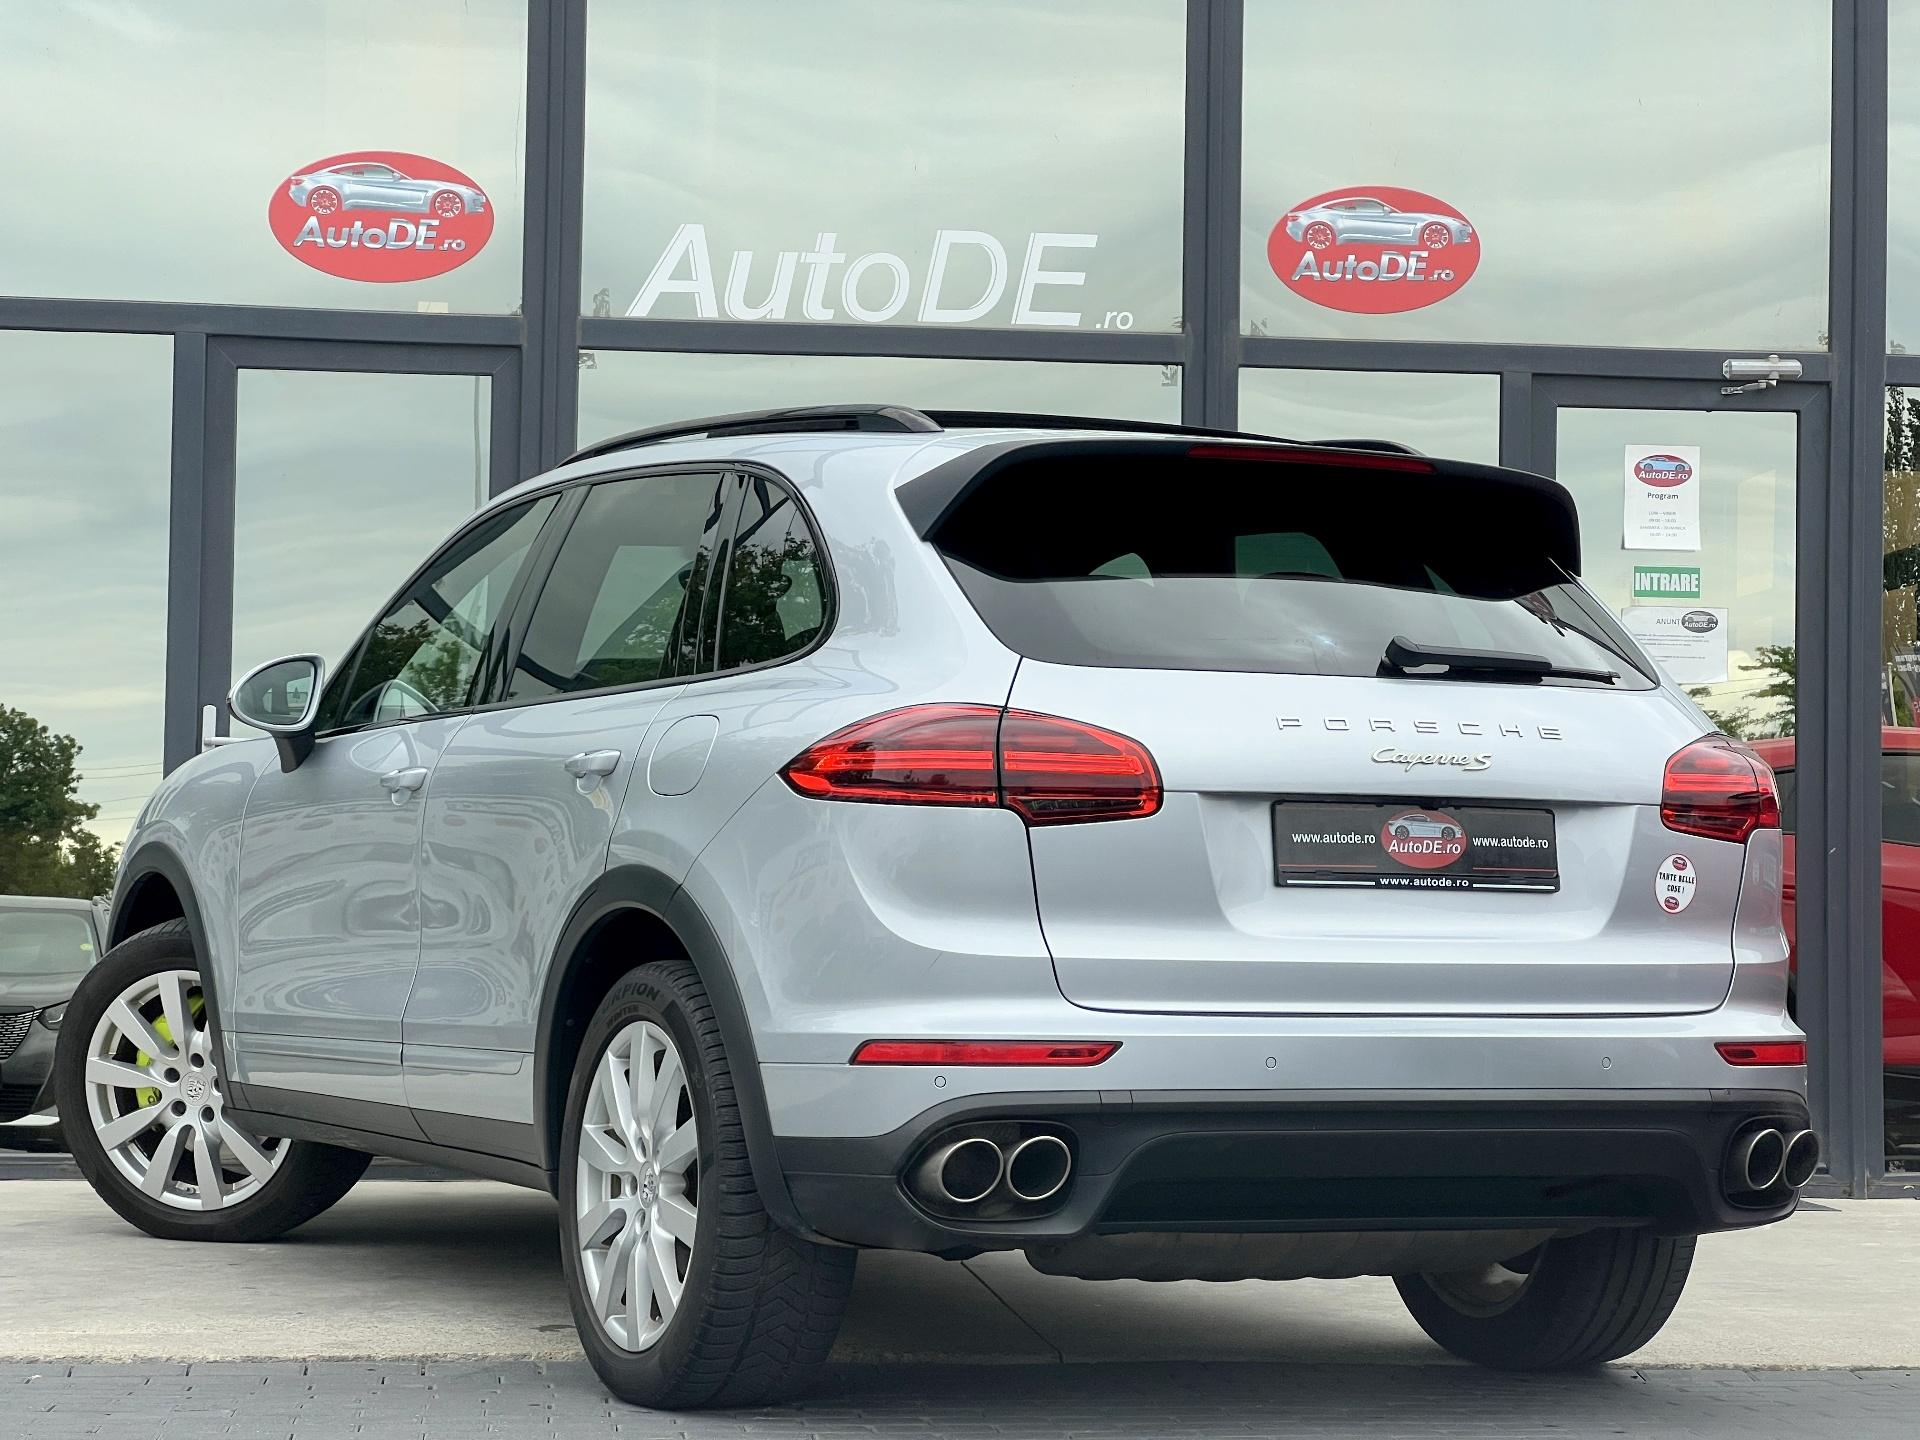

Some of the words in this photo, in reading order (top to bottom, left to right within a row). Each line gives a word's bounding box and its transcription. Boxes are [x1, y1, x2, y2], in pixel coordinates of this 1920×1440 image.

[1638, 470, 1689, 480] AutoDE.ro
[1647, 492, 1679, 501] Program
[1635, 572, 1699, 592] INTRARE
[1683, 621, 1716, 629] AutoDE.ro
[1276, 714, 1563, 741] PORSCHE
[1292, 831, 1376, 845] www.autode.ro
[1472, 836, 1549, 850] www.autode.ro
[1388, 838, 1461, 854] AutoDE.ro
[1379, 875, 1470, 887] www.autode.ro
[1659, 871, 1677, 882] TANTE
